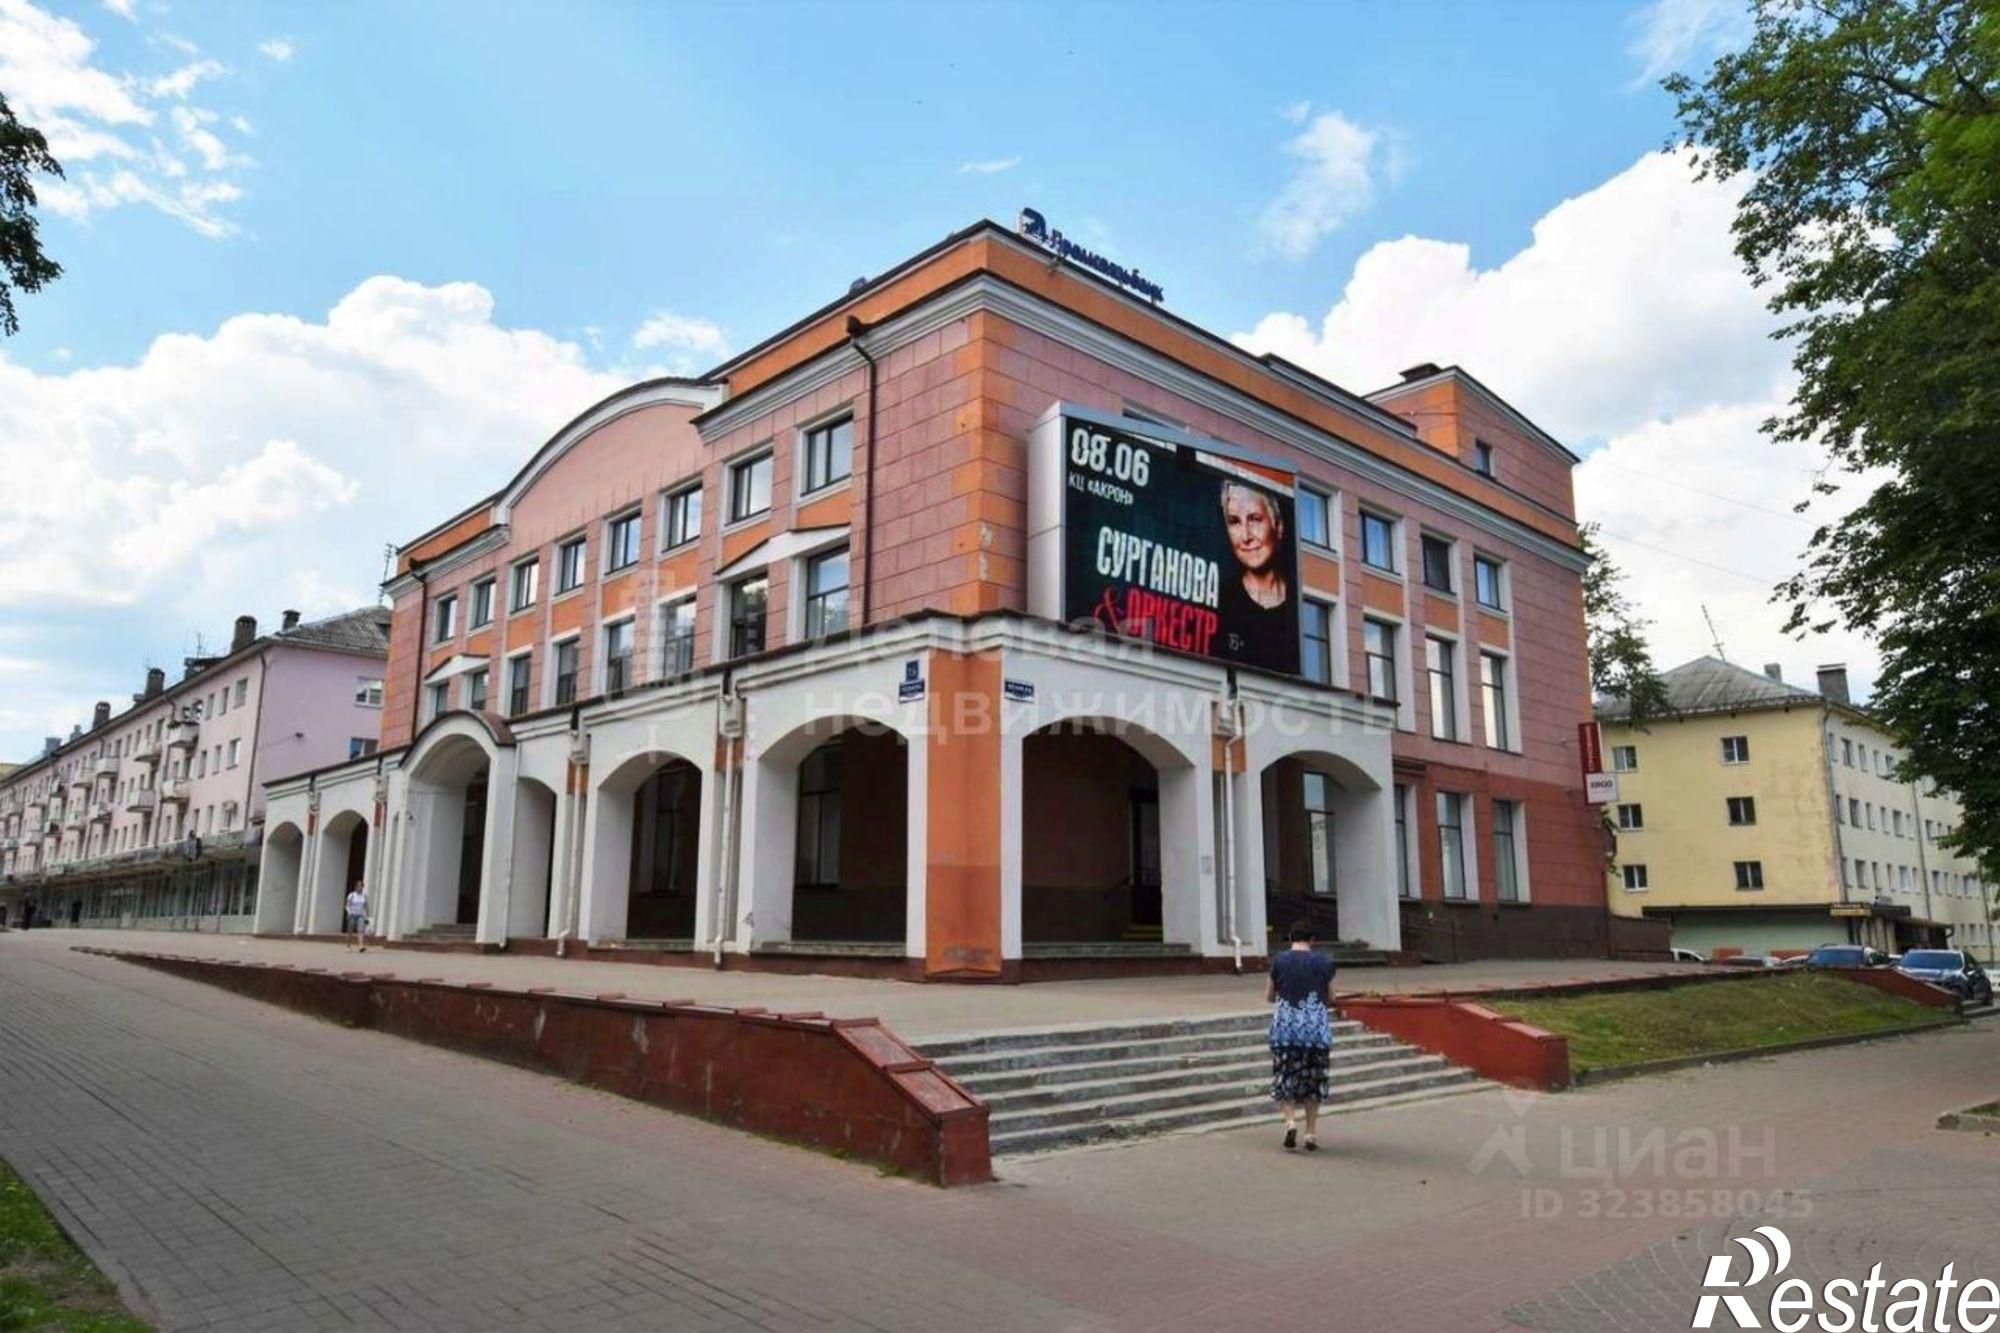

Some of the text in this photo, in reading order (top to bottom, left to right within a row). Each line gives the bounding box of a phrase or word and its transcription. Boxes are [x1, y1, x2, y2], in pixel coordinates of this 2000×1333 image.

[1071, 427, 1150, 487] 08.06
[1097, 525, 1220, 609] СУРГАНОВА
[1124, 587, 1219, 656] ОРКЕСТР
